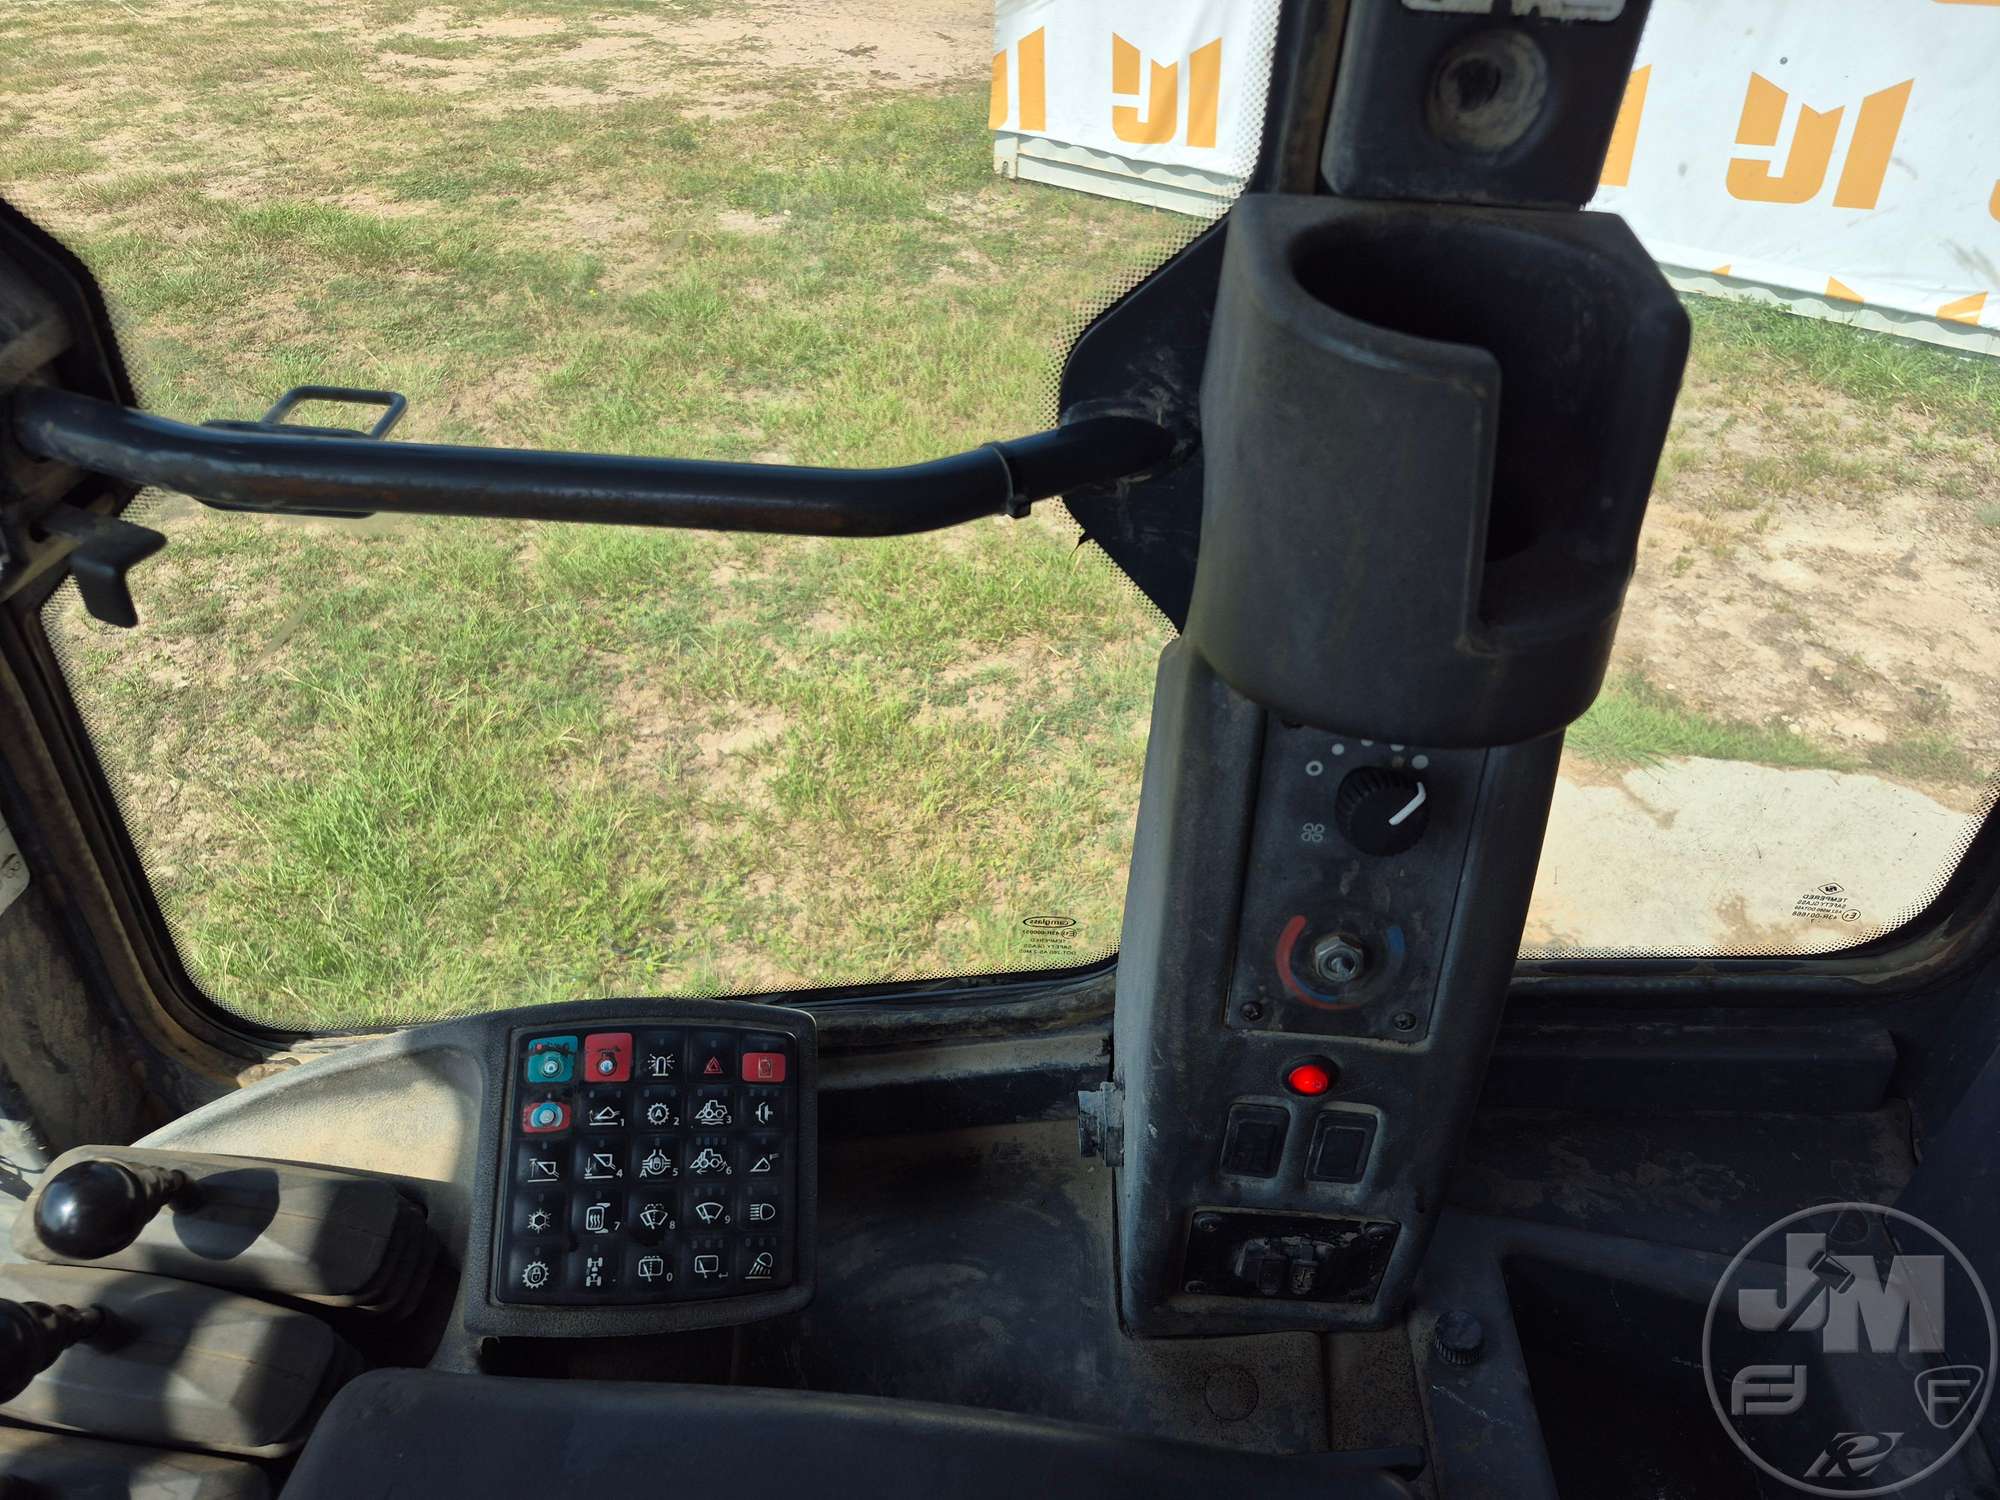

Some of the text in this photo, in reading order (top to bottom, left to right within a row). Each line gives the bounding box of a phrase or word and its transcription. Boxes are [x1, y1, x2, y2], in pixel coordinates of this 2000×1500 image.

[619, 1118, 625, 1127] 1
[673, 1117, 680, 1126] 2
[726, 1115, 732, 1124] 3
[616, 1169, 623, 1178] 4
[639, 1169, 647, 1178] A
[672, 1168, 679, 1177] 5
[725, 1166, 732, 1175] 6
[724, 1215, 731, 1224] 9
[613, 1221, 621, 1231] 7
[669, 1220, 676, 1230] 8
